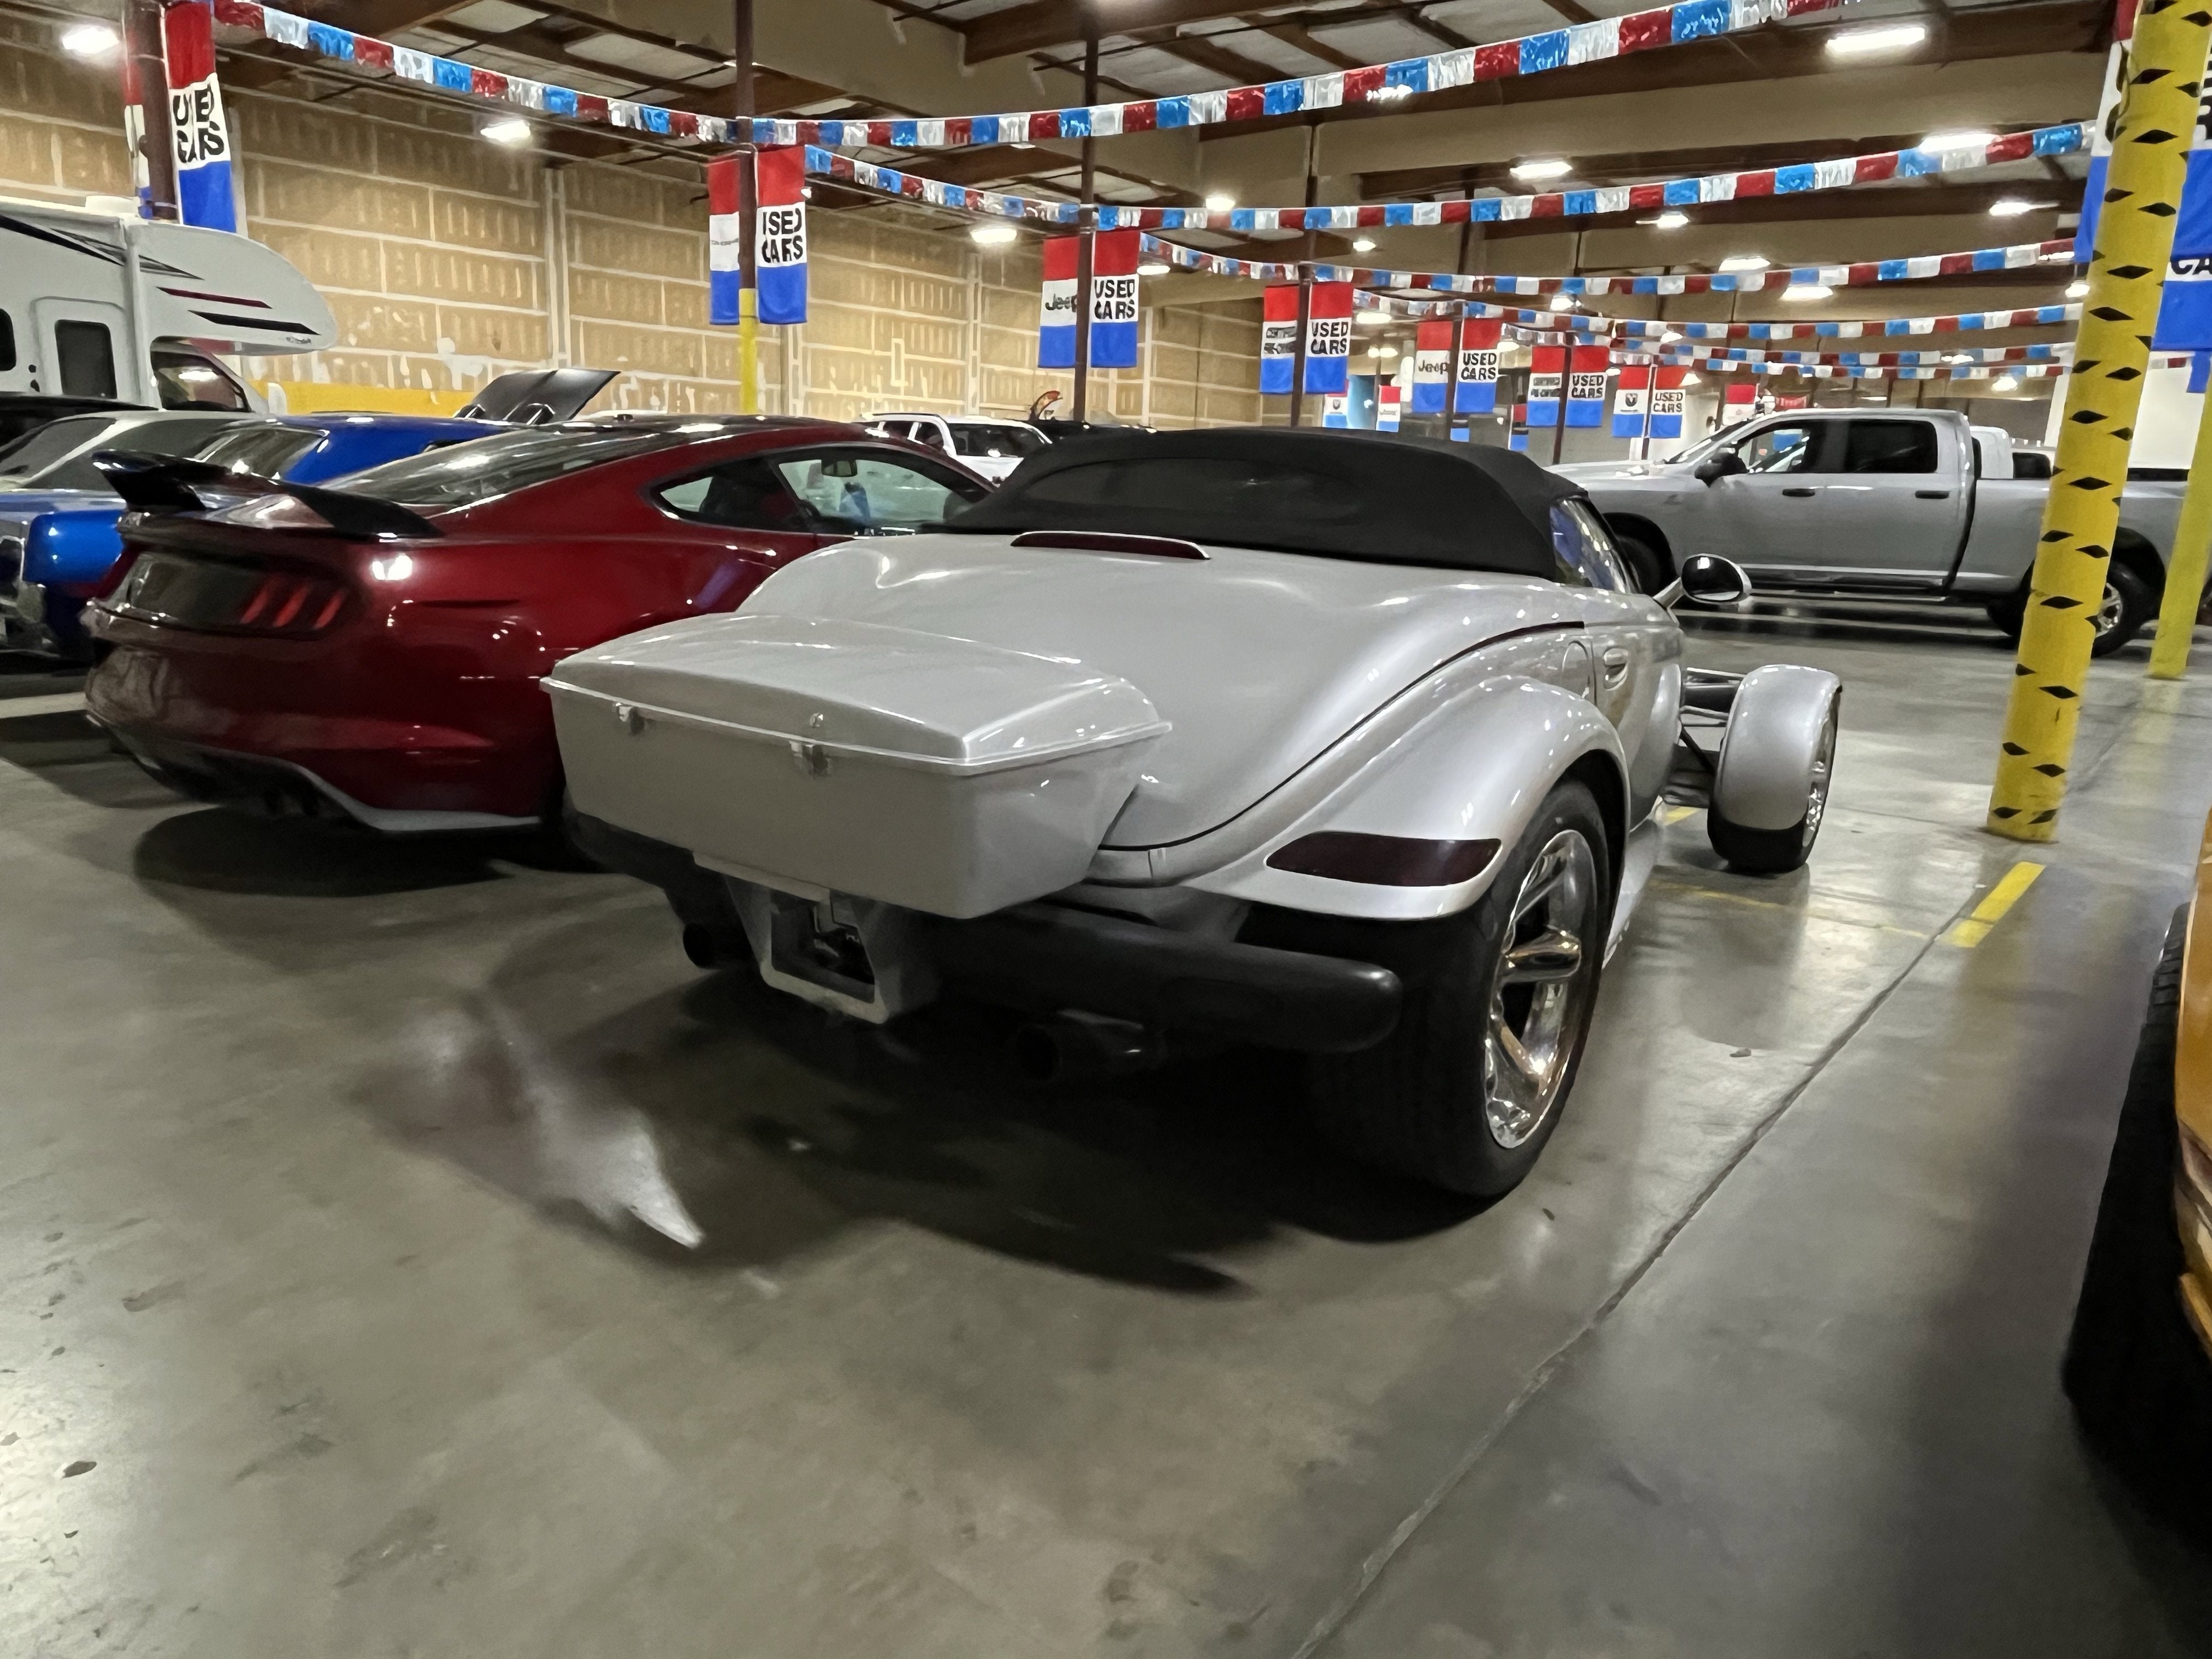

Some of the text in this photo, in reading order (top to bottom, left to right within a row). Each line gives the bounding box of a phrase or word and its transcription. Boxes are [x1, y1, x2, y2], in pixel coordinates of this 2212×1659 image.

[761, 235, 803, 263] CARS
[1094, 279, 1135, 298] USED
[1094, 299, 1135, 319] CARS
[1312, 321, 1348, 337] USED
[1311, 338, 1347, 354] CARS
[1463, 352, 1497, 365] USED
[1461, 366, 1496, 380] CARS
[1572, 375, 1604, 386] USED
[1571, 387, 1602, 398] CARS
[1655, 392, 1683, 401] USED
[1654, 403, 1682, 413] CARS
